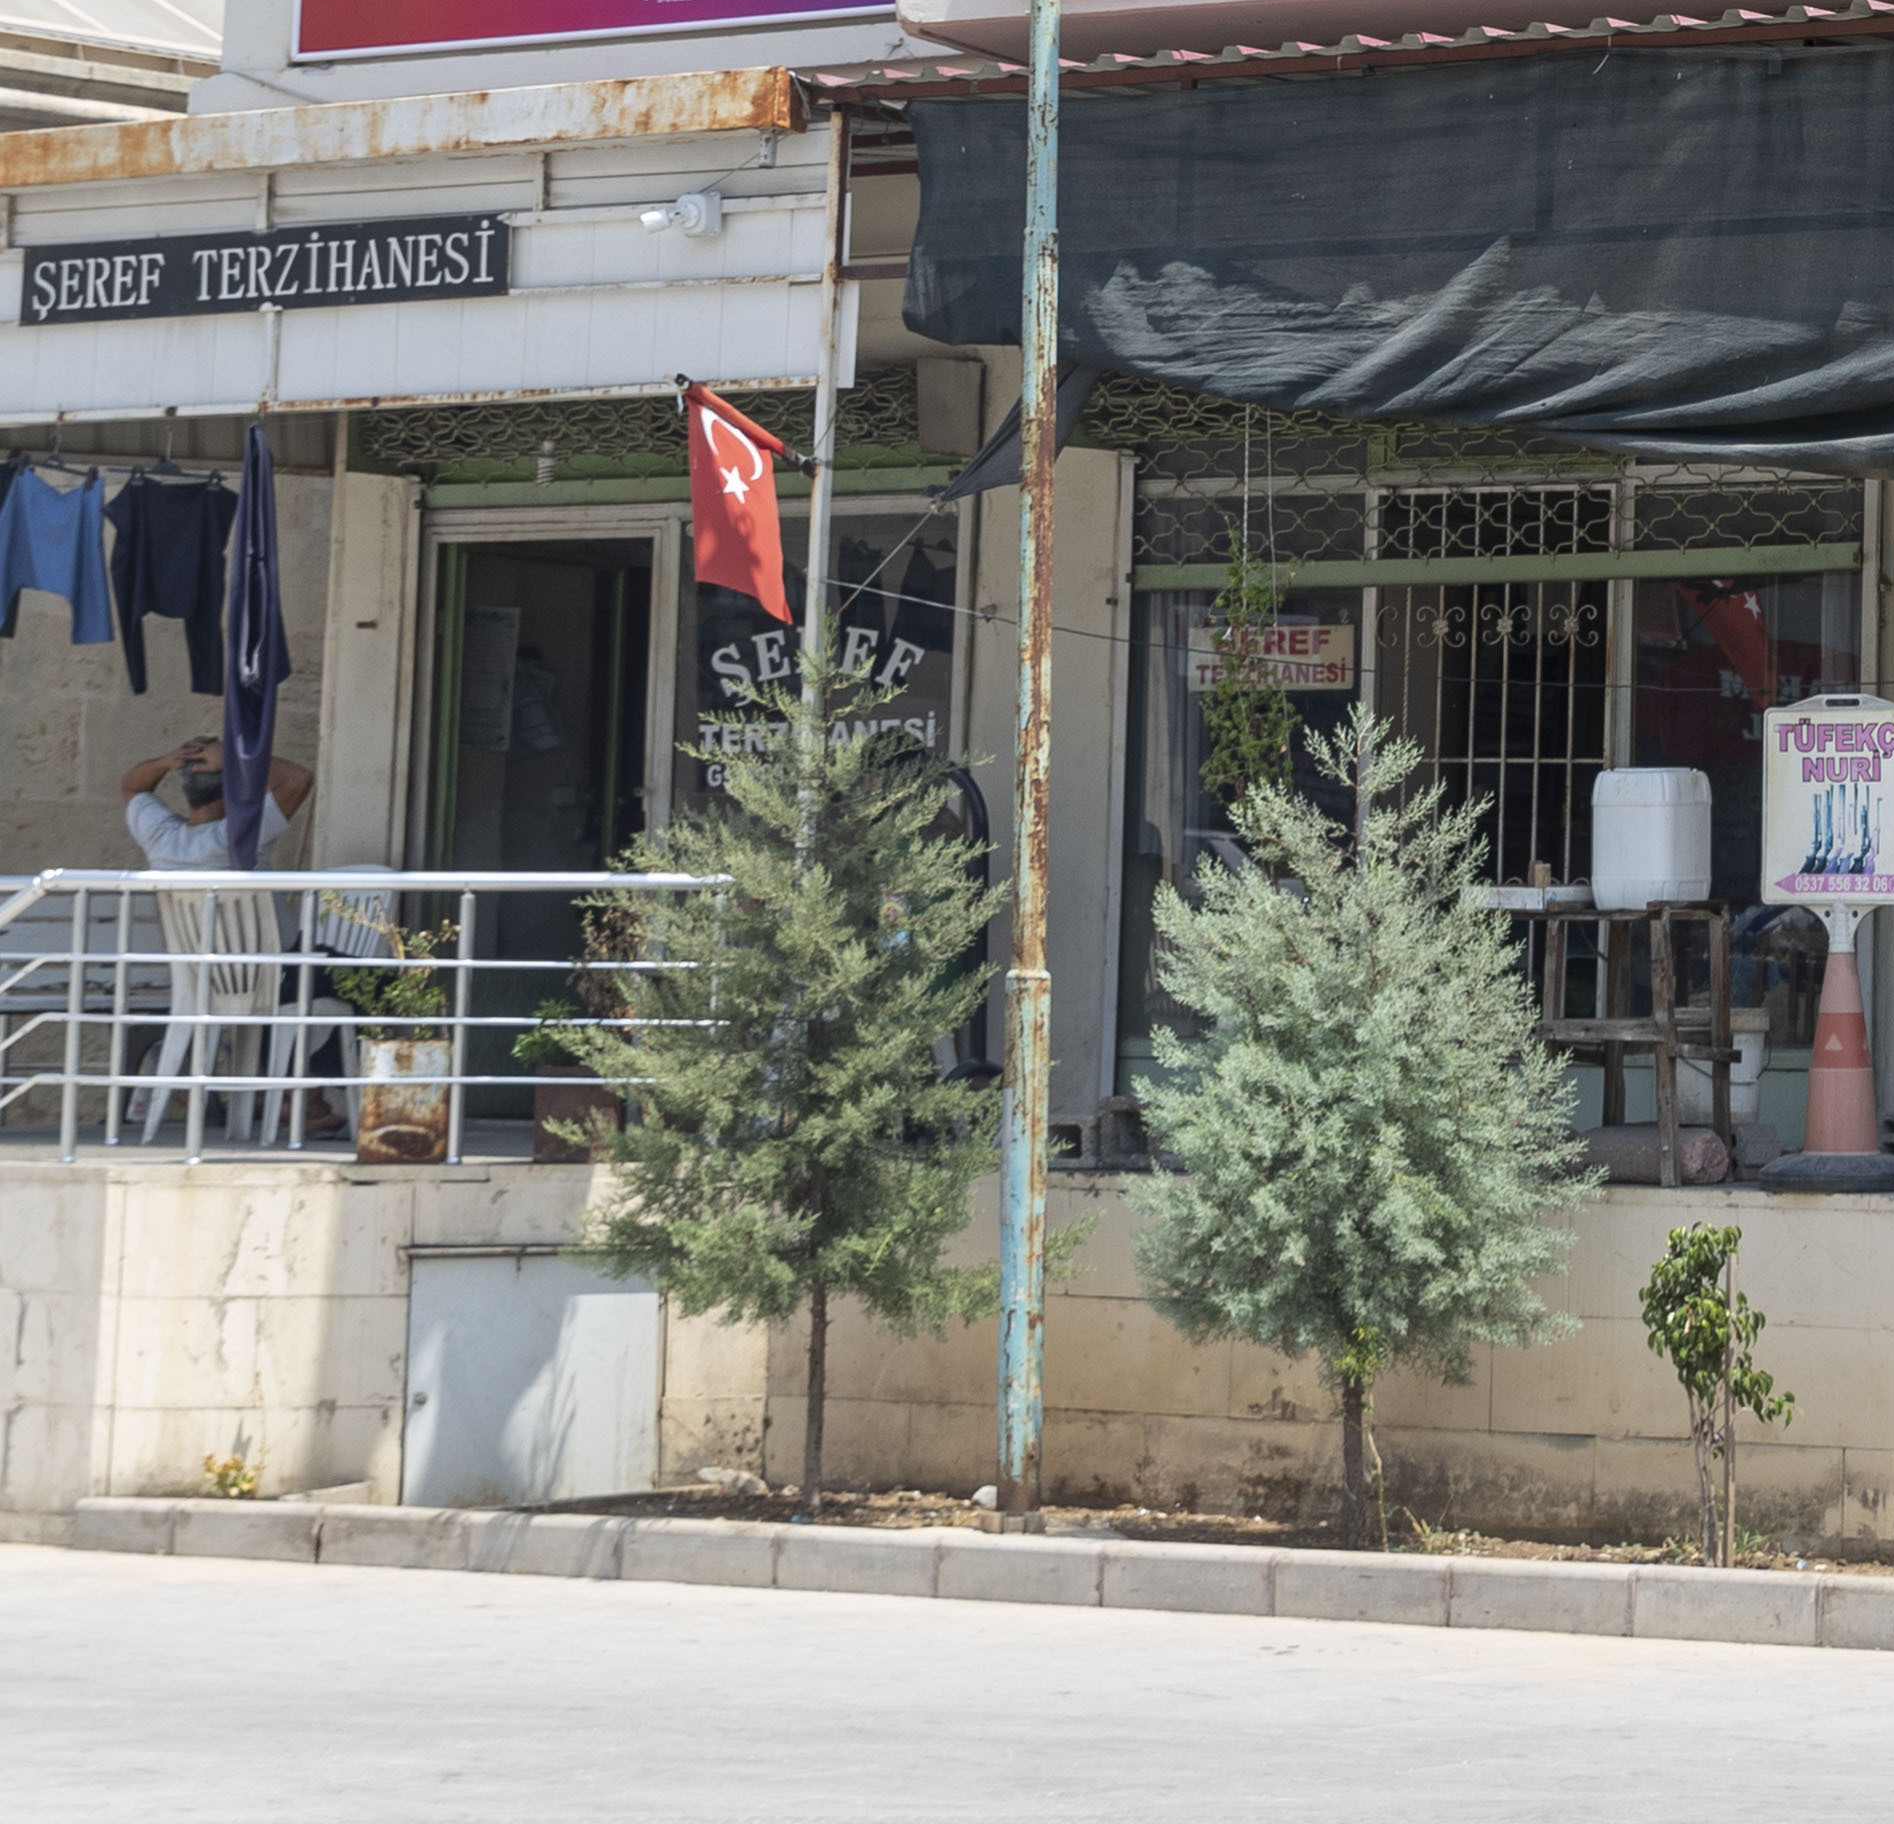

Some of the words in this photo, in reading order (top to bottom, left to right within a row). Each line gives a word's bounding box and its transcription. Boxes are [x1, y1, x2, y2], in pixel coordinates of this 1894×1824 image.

[32, 253, 165, 321] ŞEREF
[192, 219, 495, 302] TERZİHANESİ
[1802, 749, 1882, 783] NURİ
[1795, 876, 1825, 892] 0537
[1828, 876, 1851, 892] 556
[1854, 876, 1870, 892] 32
